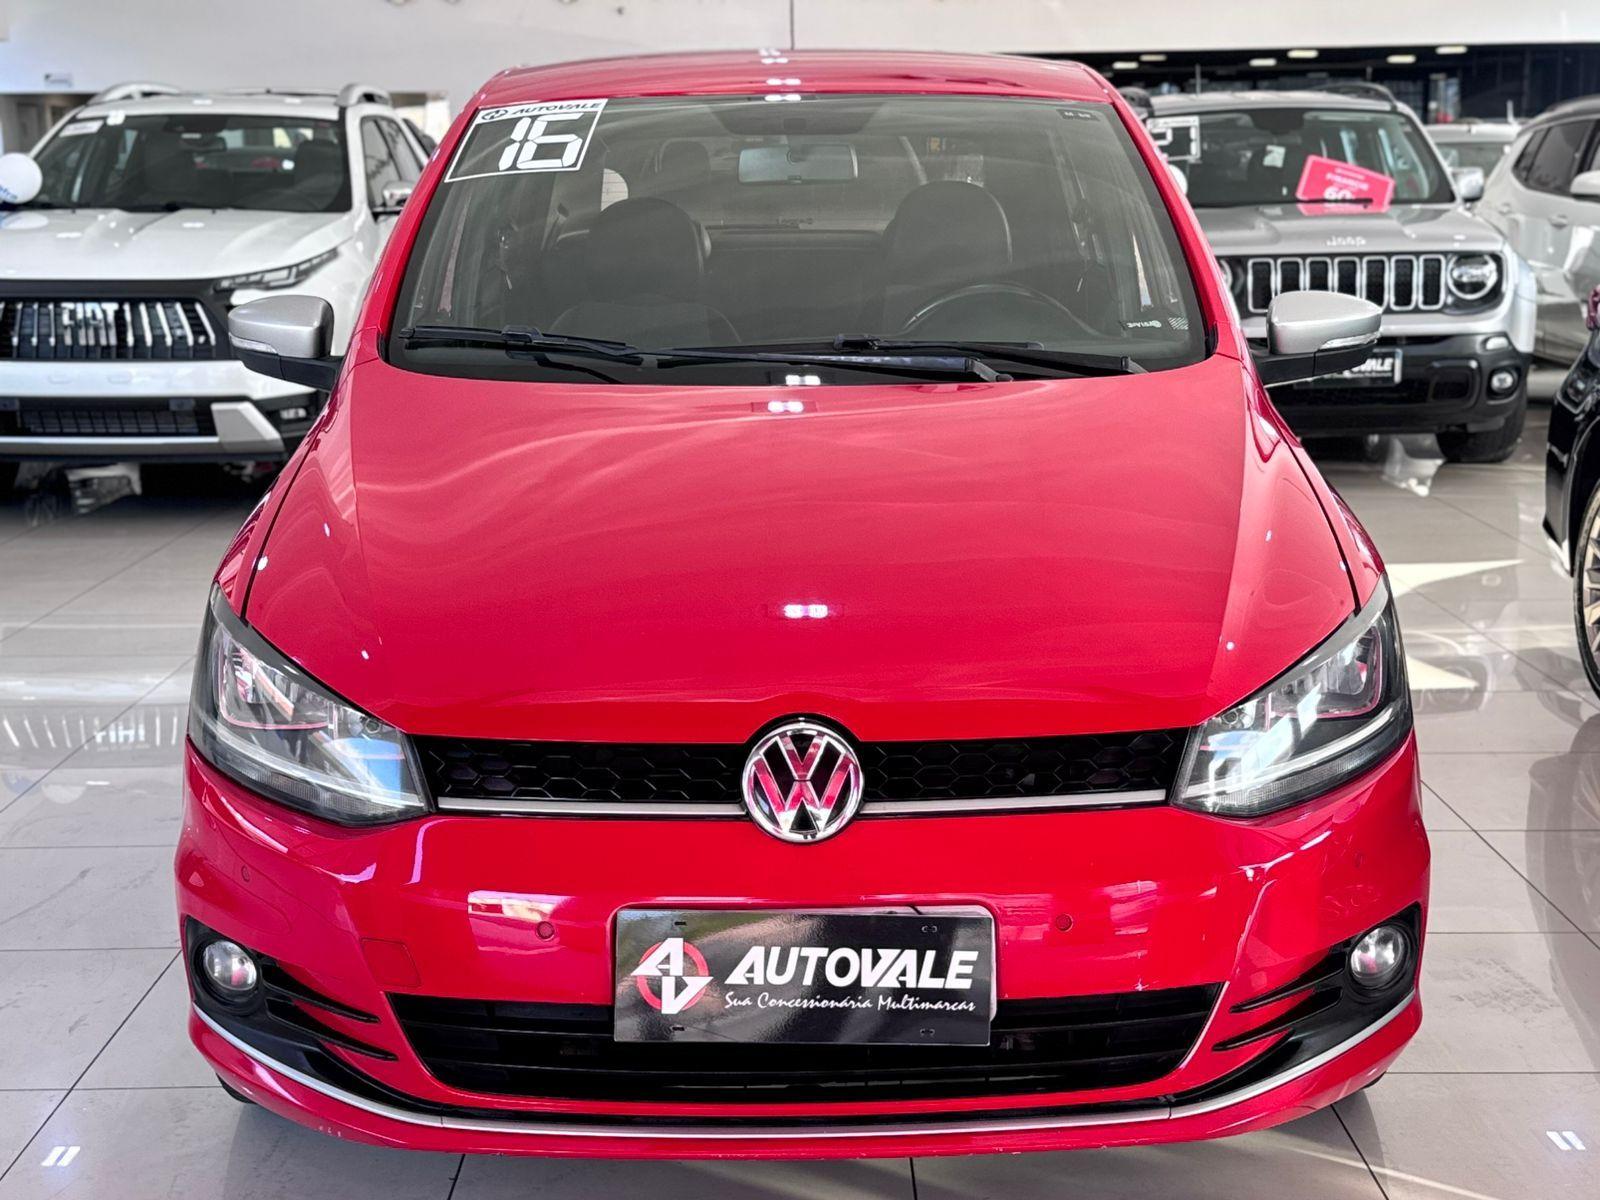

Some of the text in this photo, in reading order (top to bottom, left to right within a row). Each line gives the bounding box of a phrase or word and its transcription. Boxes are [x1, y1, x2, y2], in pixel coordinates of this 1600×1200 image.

[512, 102, 601, 116] AUTOVALE
[498, 112, 584, 171] 16
[60, 301, 120, 325] FIAT
[724, 945, 979, 990] AUTOVALE
[724, 990, 977, 1013] Sua Concessionária Multimarcas
